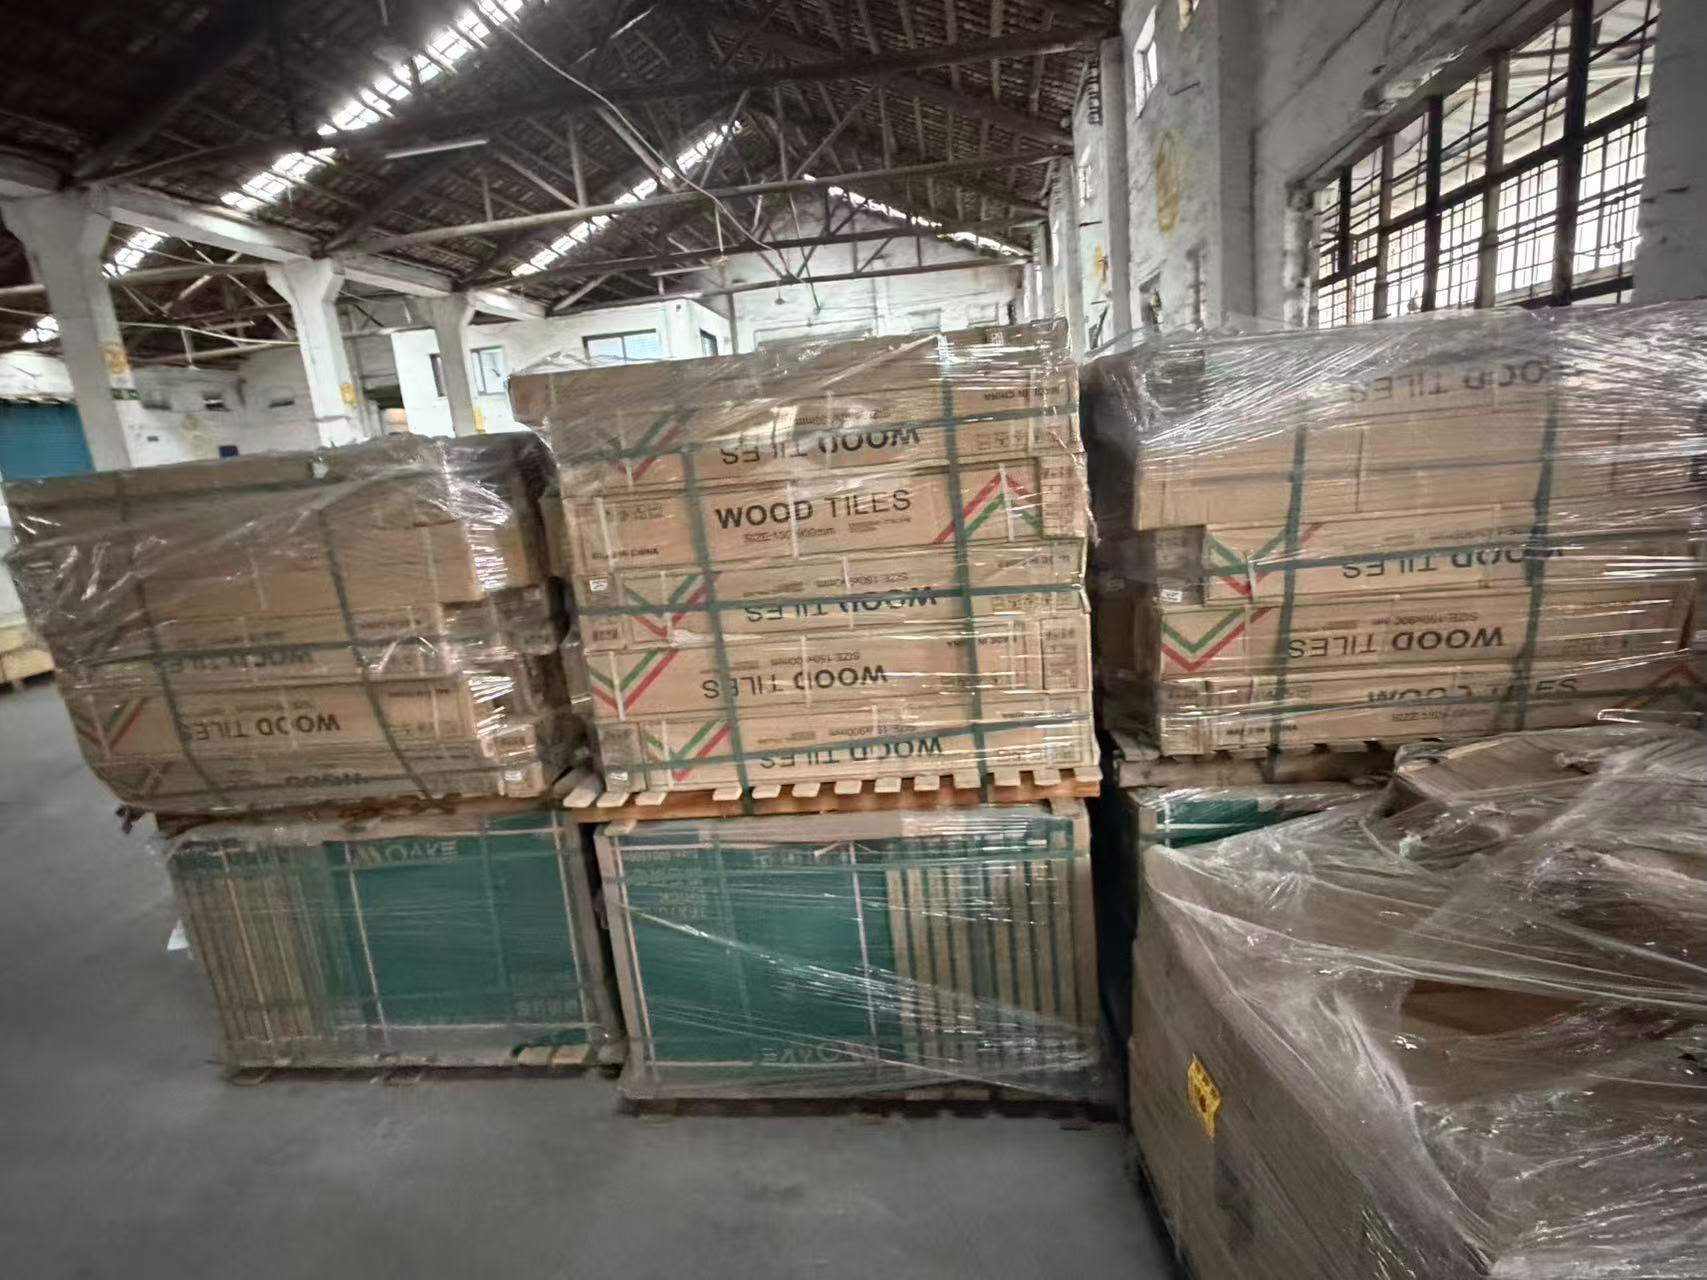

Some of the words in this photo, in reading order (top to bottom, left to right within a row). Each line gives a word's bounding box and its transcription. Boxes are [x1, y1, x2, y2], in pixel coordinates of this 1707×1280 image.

[1463, 359, 1550, 390] OOD
[715, 500, 814, 529] WOOD
[824, 489, 912, 518] TILES
[1287, 633, 1377, 659] TILES
[1392, 626, 1504, 651] WOOD
[793, 664, 888, 690] WOOD
